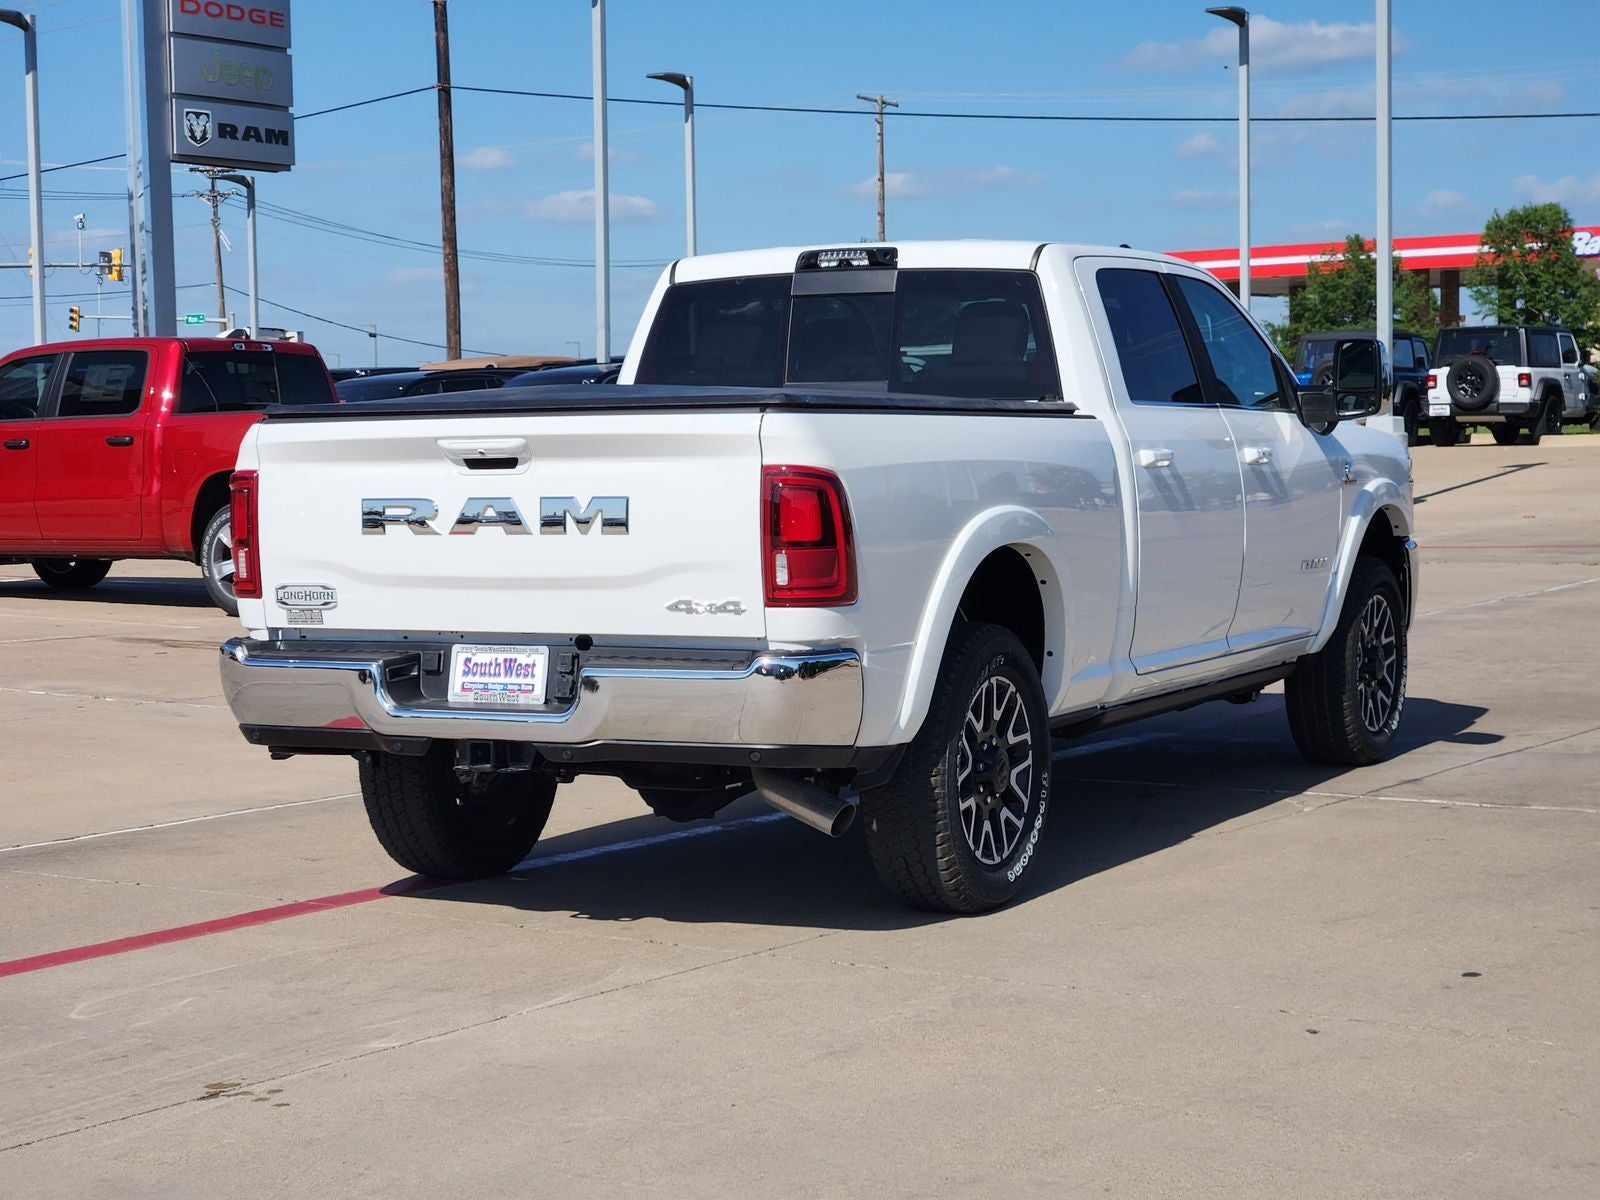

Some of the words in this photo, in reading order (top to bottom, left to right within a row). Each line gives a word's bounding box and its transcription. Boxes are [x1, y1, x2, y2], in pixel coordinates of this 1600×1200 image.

[180, 0, 285, 28] DODGE
[202, 49, 273, 92] Jeep
[217, 122, 289, 146] RAM
[361, 496, 630, 536] RAM
